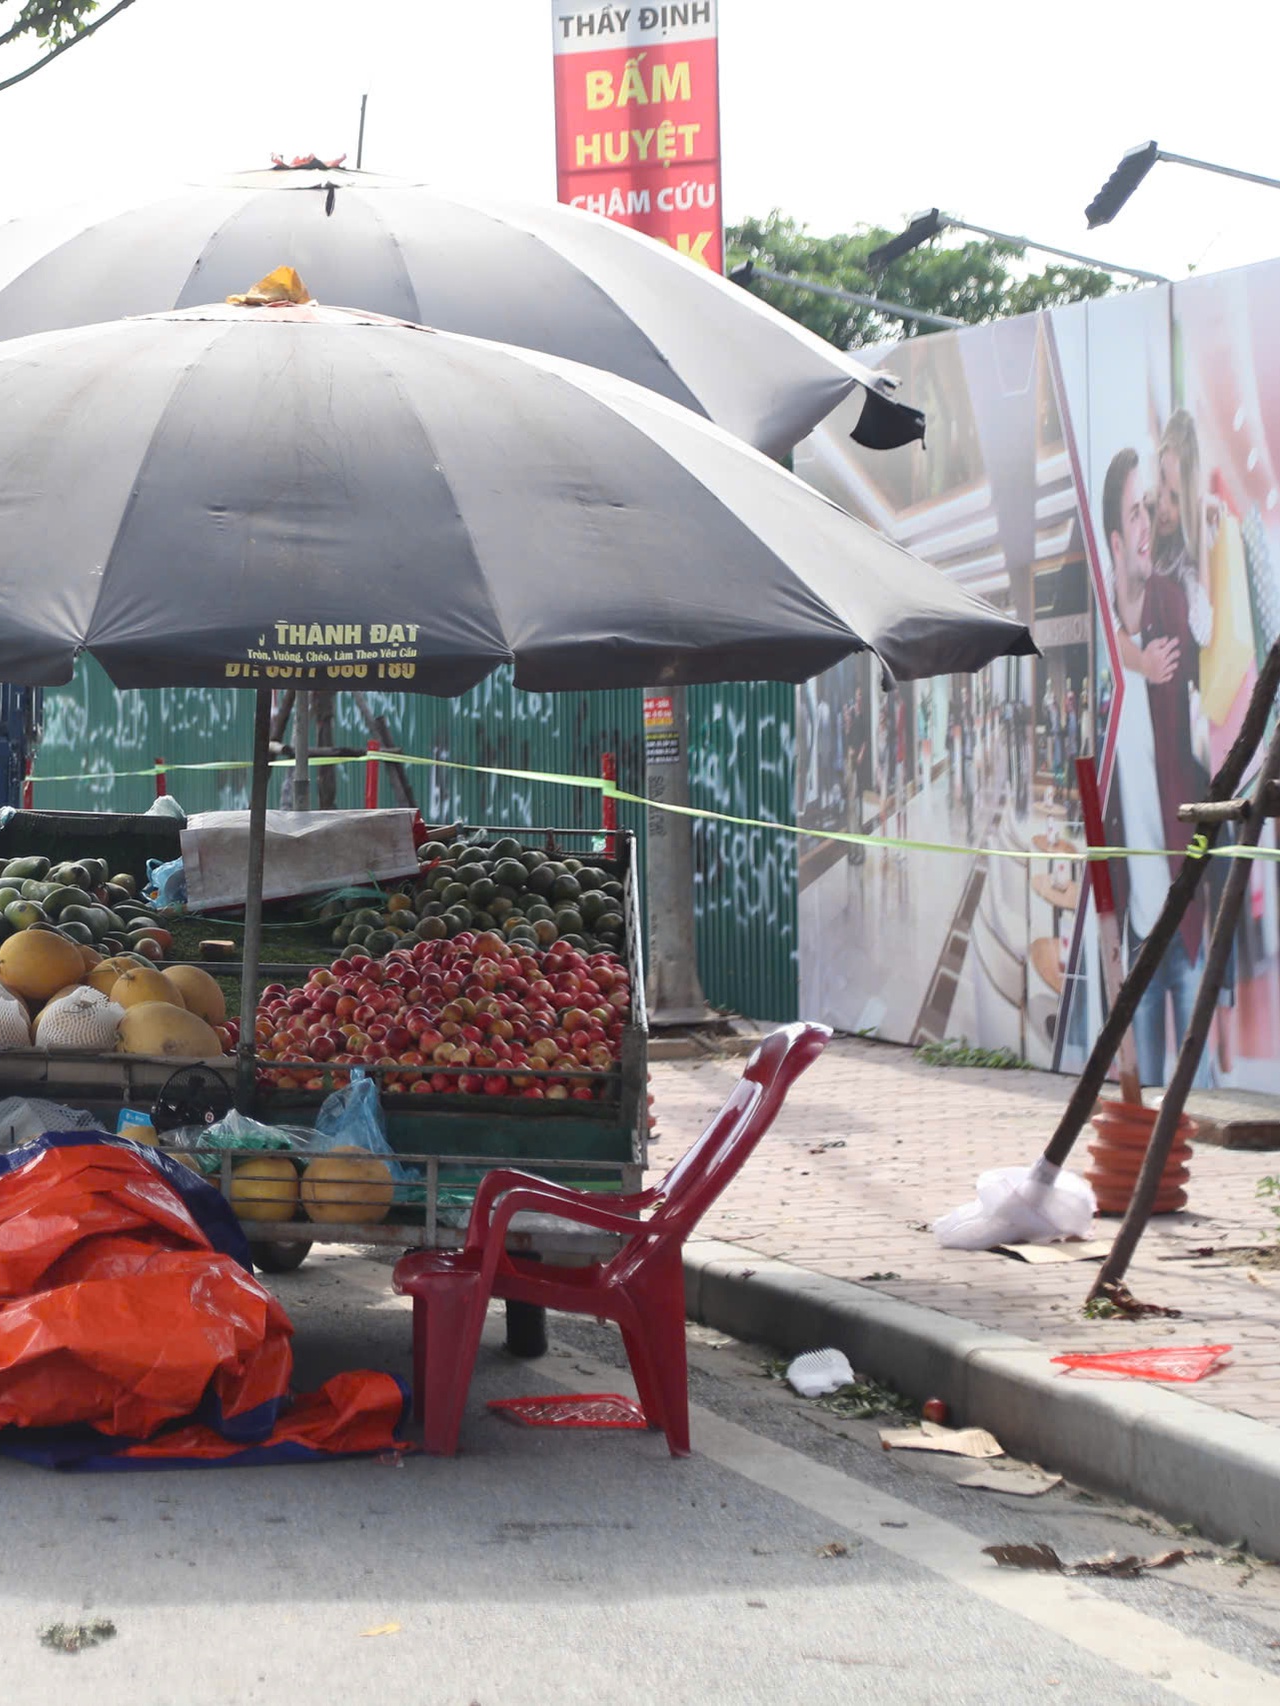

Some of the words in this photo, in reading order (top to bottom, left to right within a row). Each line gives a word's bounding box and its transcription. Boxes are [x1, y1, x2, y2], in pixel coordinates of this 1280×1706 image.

[638, 0, 710, 35] ĐỊNH
[585, 52, 691, 110] BẤM
[576, 120, 700, 168] HUYỆT
[657, 181, 716, 212] CỨU
[274, 622, 362, 645] THÀNH
[369, 624, 419, 647] ĐẠT
